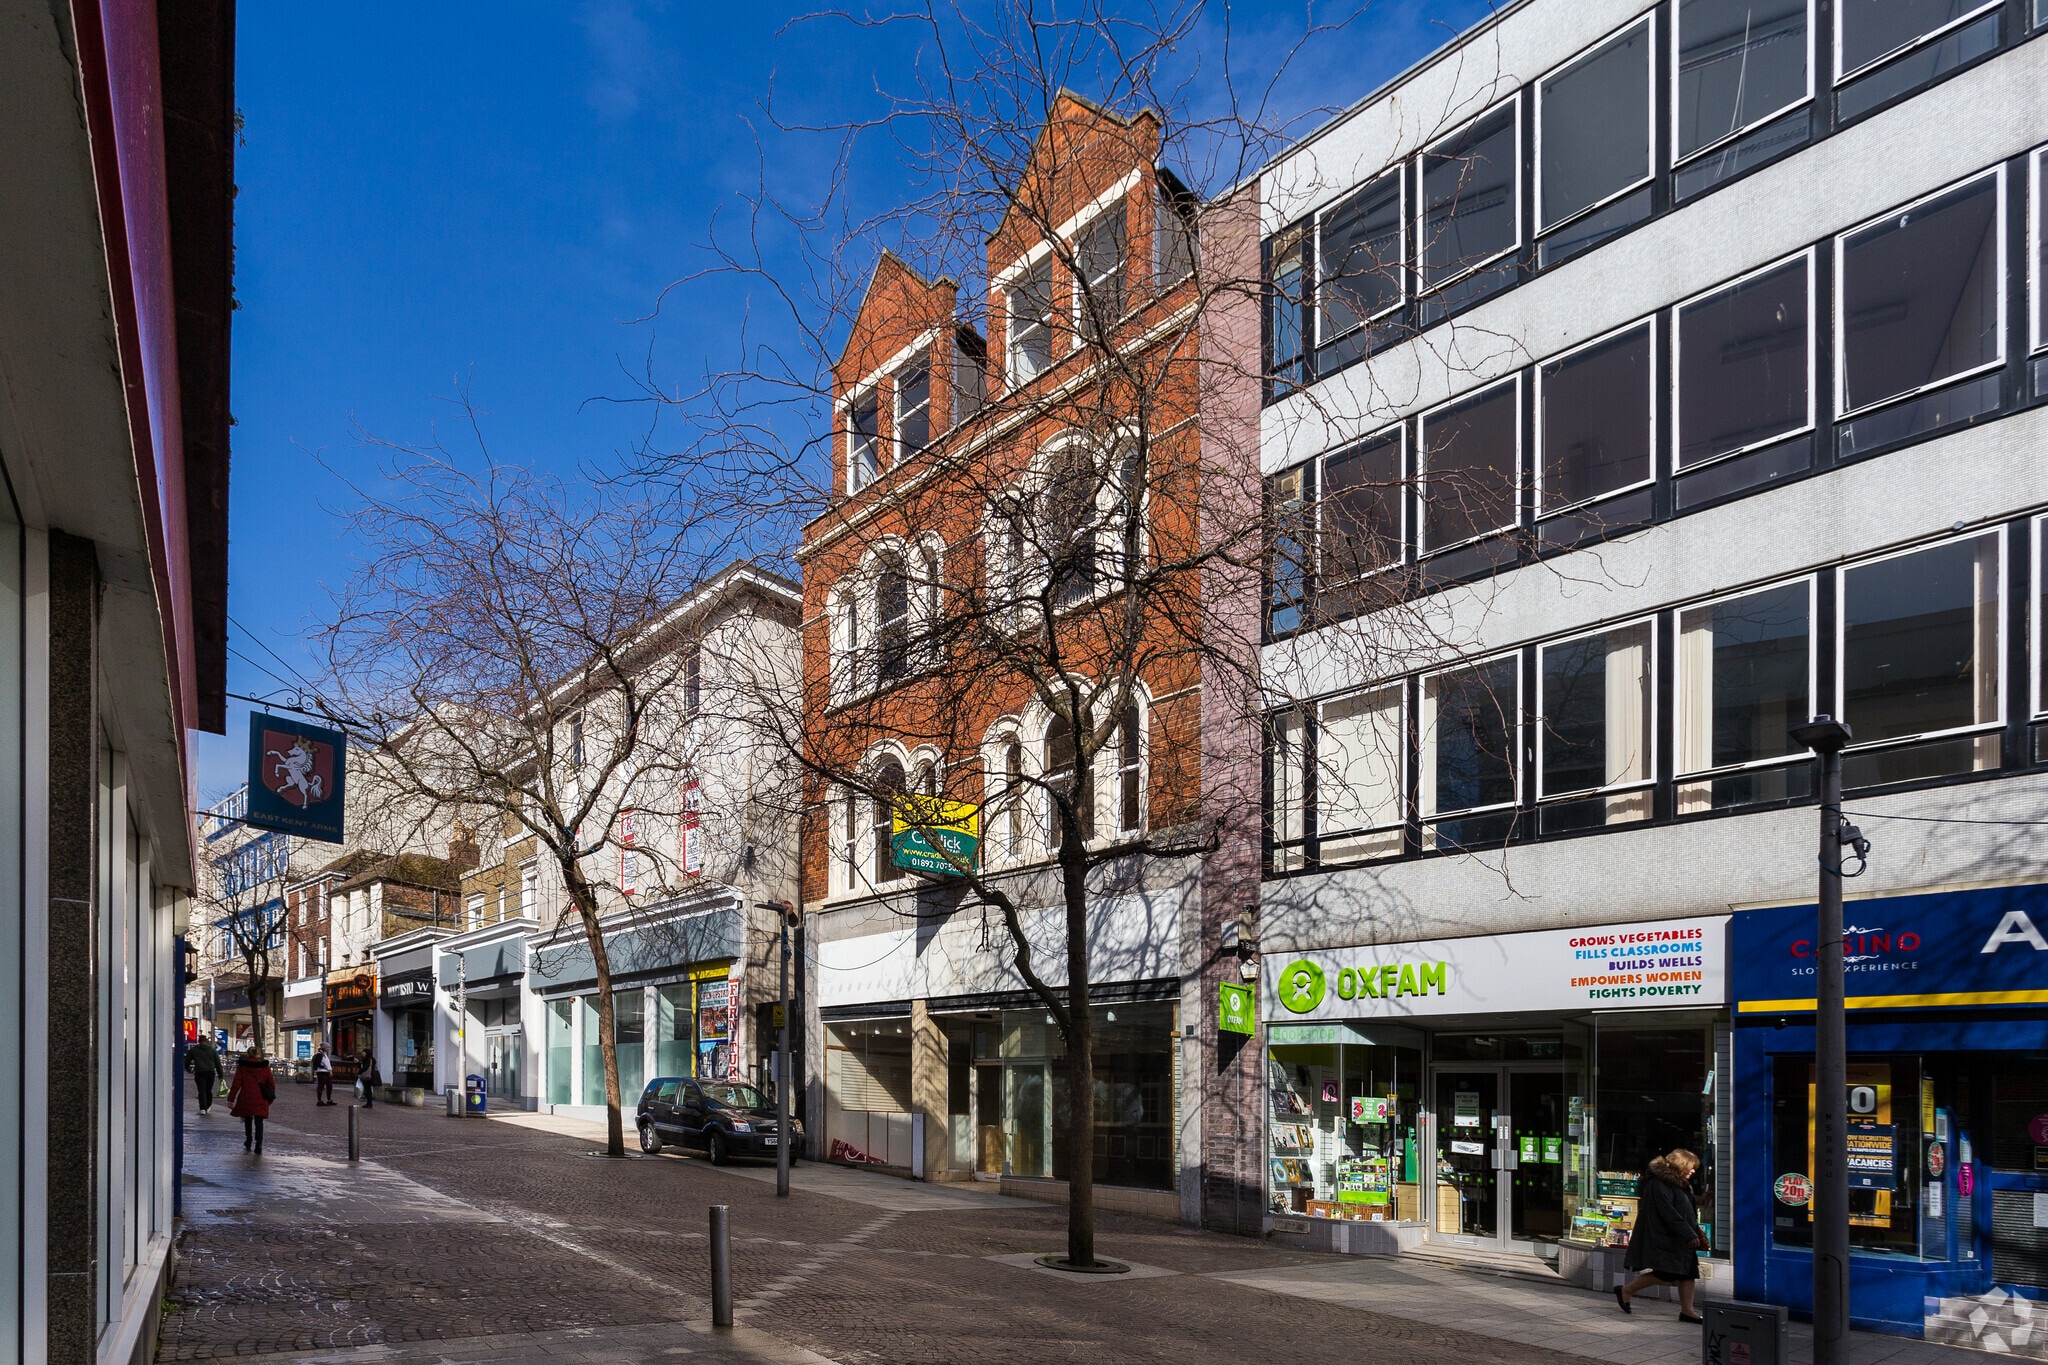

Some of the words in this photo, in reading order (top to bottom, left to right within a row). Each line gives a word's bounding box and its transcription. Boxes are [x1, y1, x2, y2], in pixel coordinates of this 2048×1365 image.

[253, 811, 279, 821] EAST
[282, 817, 308, 827] KENT
[912, 858, 934, 869] 01892
[1569, 936, 1615, 948] GROWS
[1619, 928, 1703, 944] VEGETABLES
[1790, 932, 1920, 958] CSINO
[1575, 948, 1608, 960] FILLS
[1611, 941, 1703, 957] CLASSROOMS
[1609, 959, 1655, 971] BUILDS
[1658, 956, 1703, 968] WELLS
[1843, 961, 1919, 973] XPERIENCE
[1337, 961, 1446, 1000] OXFAM
[1571, 973, 1642, 987] EMPOWERS
[1646, 970, 1702, 983] WOMEN
[1589, 987, 1636, 999] FIGHTS
[1639, 984, 1702, 997] POVERTY
[1273, 1026, 1336, 1043] Bookshop
[1353, 1102, 1364, 1118] 3
[1782, 1176, 1803, 1186] PLAY
[1782, 1185, 1805, 1198] 20p
